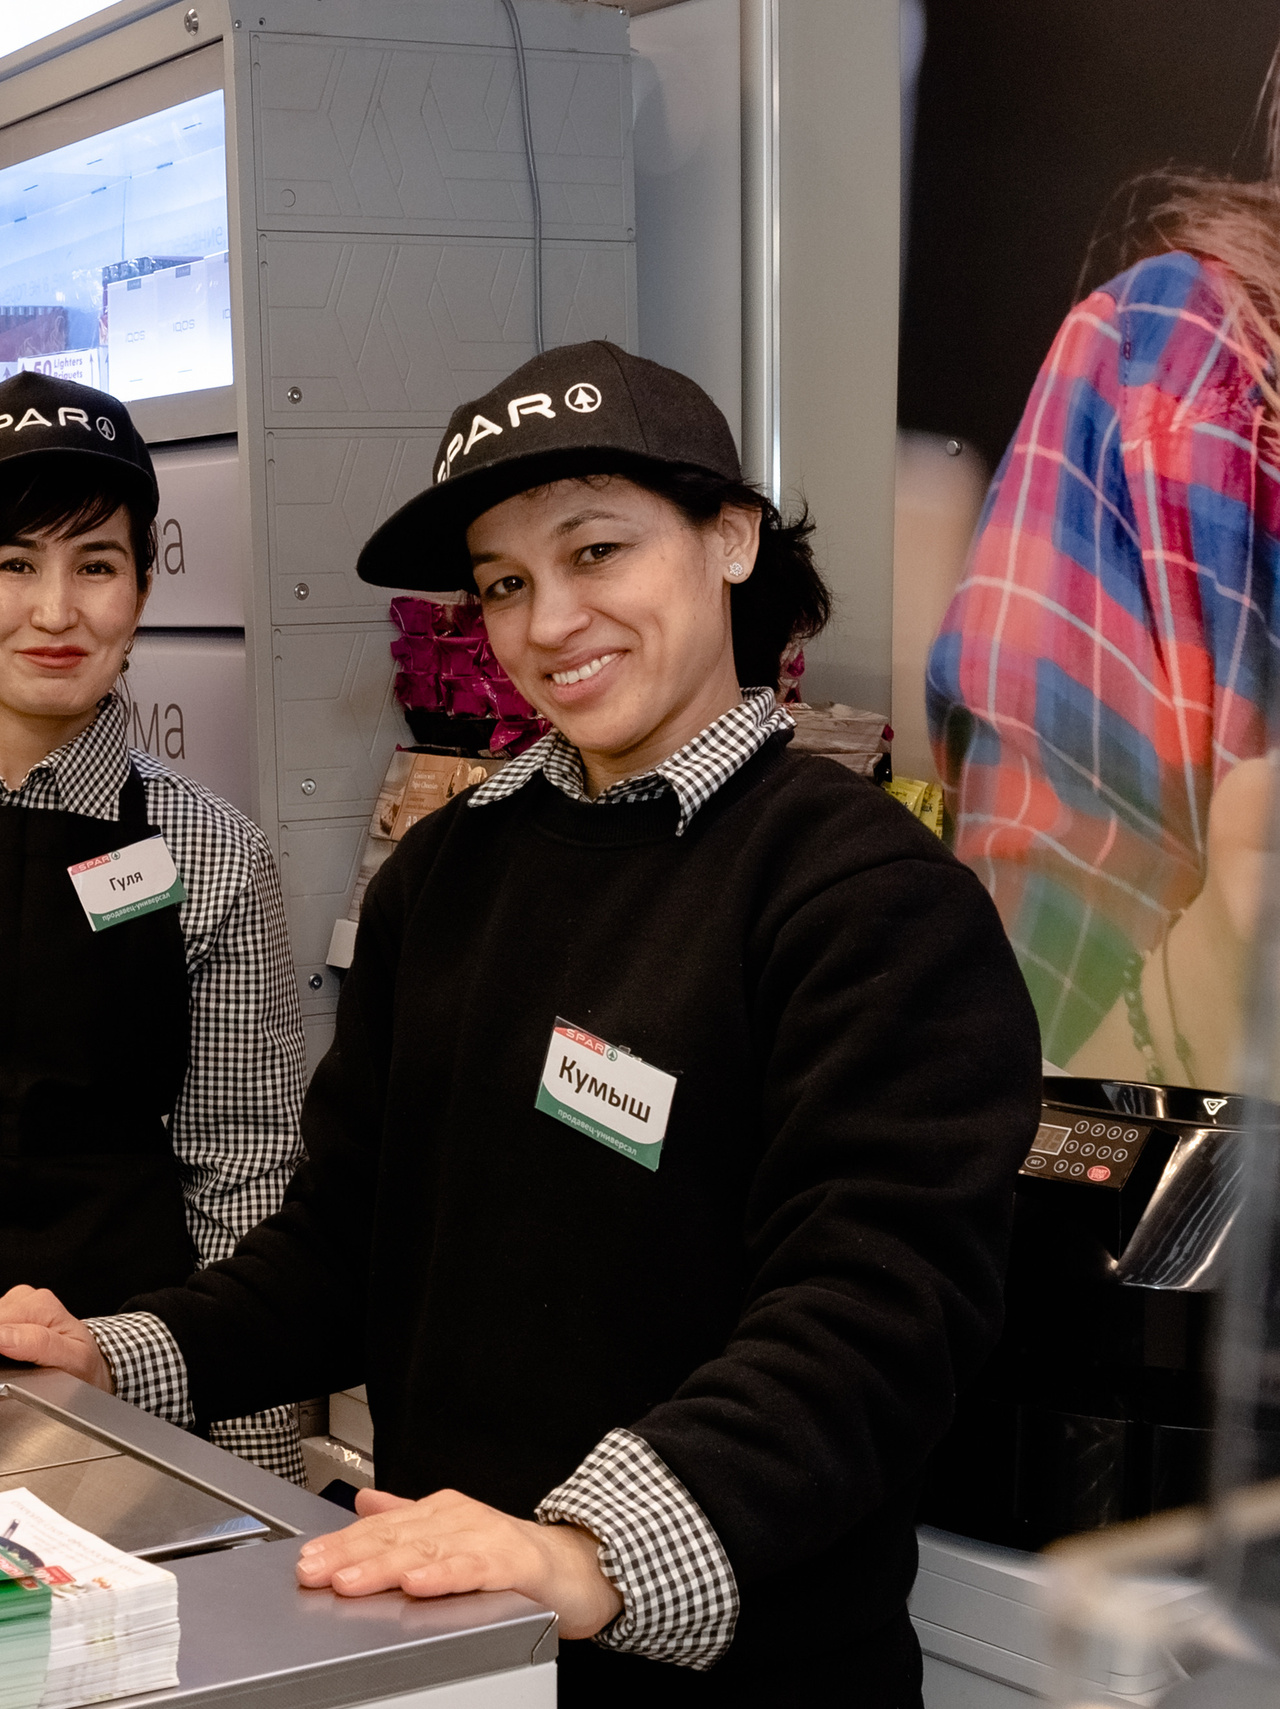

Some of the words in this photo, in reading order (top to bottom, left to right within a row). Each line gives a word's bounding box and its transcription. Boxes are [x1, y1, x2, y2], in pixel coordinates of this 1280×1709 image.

[53, 357, 83, 369] Lighters
[78, 855, 110, 871] SPAR
[109, 871, 144, 891] Гуля
[101, 892, 171, 922] продавец-универсал
[566, 1028, 605, 1055] SPAR
[558, 1055, 651, 1123] Кумыш
[557, 1108, 638, 1156] продавец-универсал
